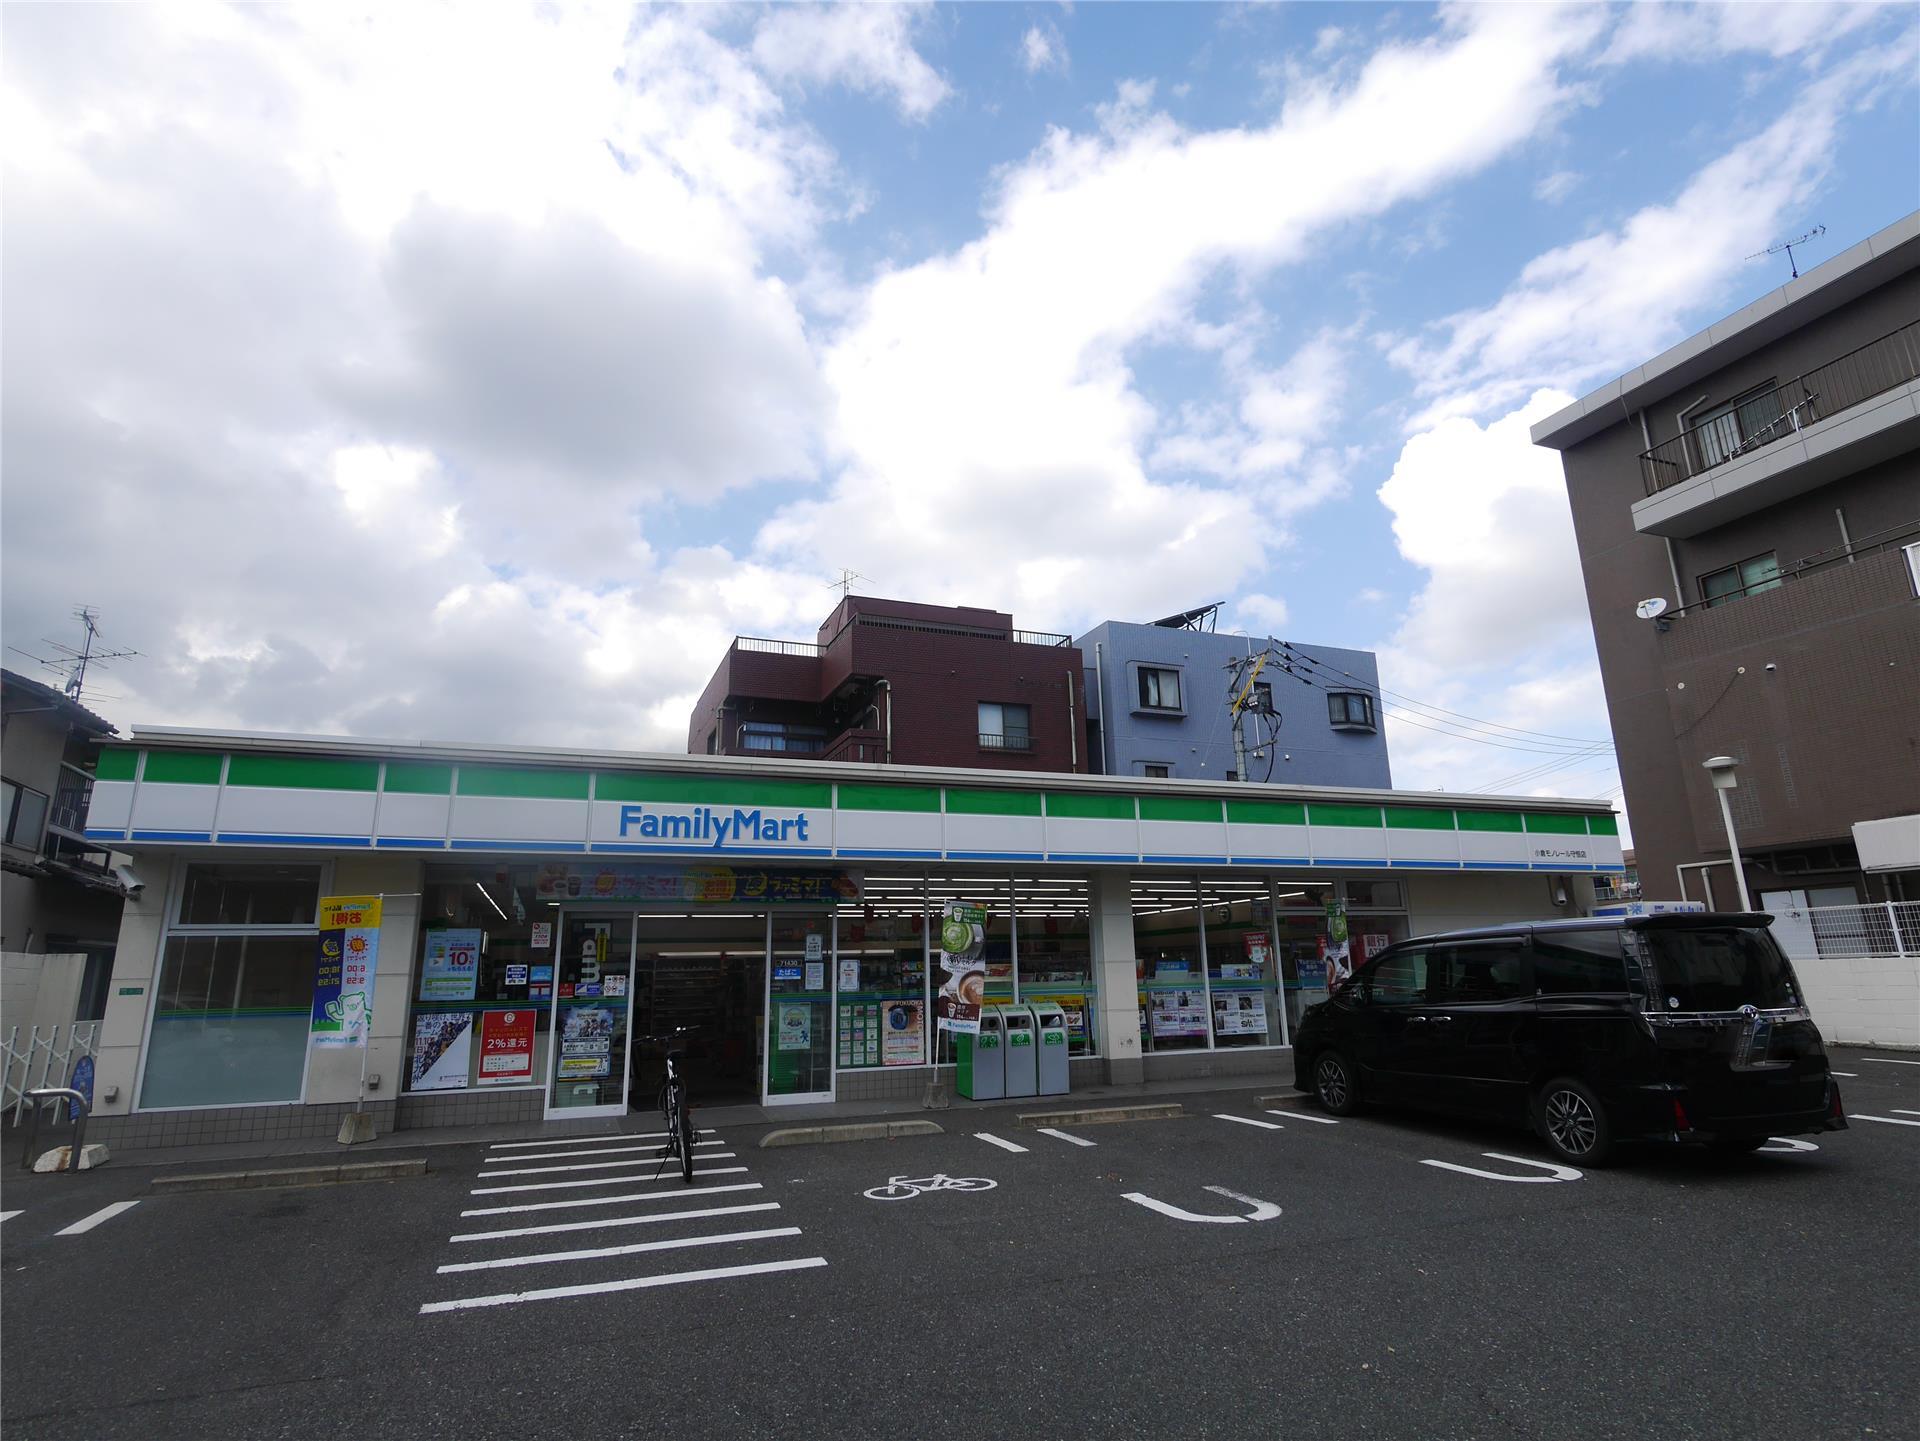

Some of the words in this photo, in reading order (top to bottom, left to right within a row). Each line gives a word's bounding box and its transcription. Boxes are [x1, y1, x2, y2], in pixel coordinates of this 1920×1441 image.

[619, 804, 809, 848] FamilyMart
[779, 969, 798, 977] たばこ
[487, 1038, 528, 1049] 2%還元
